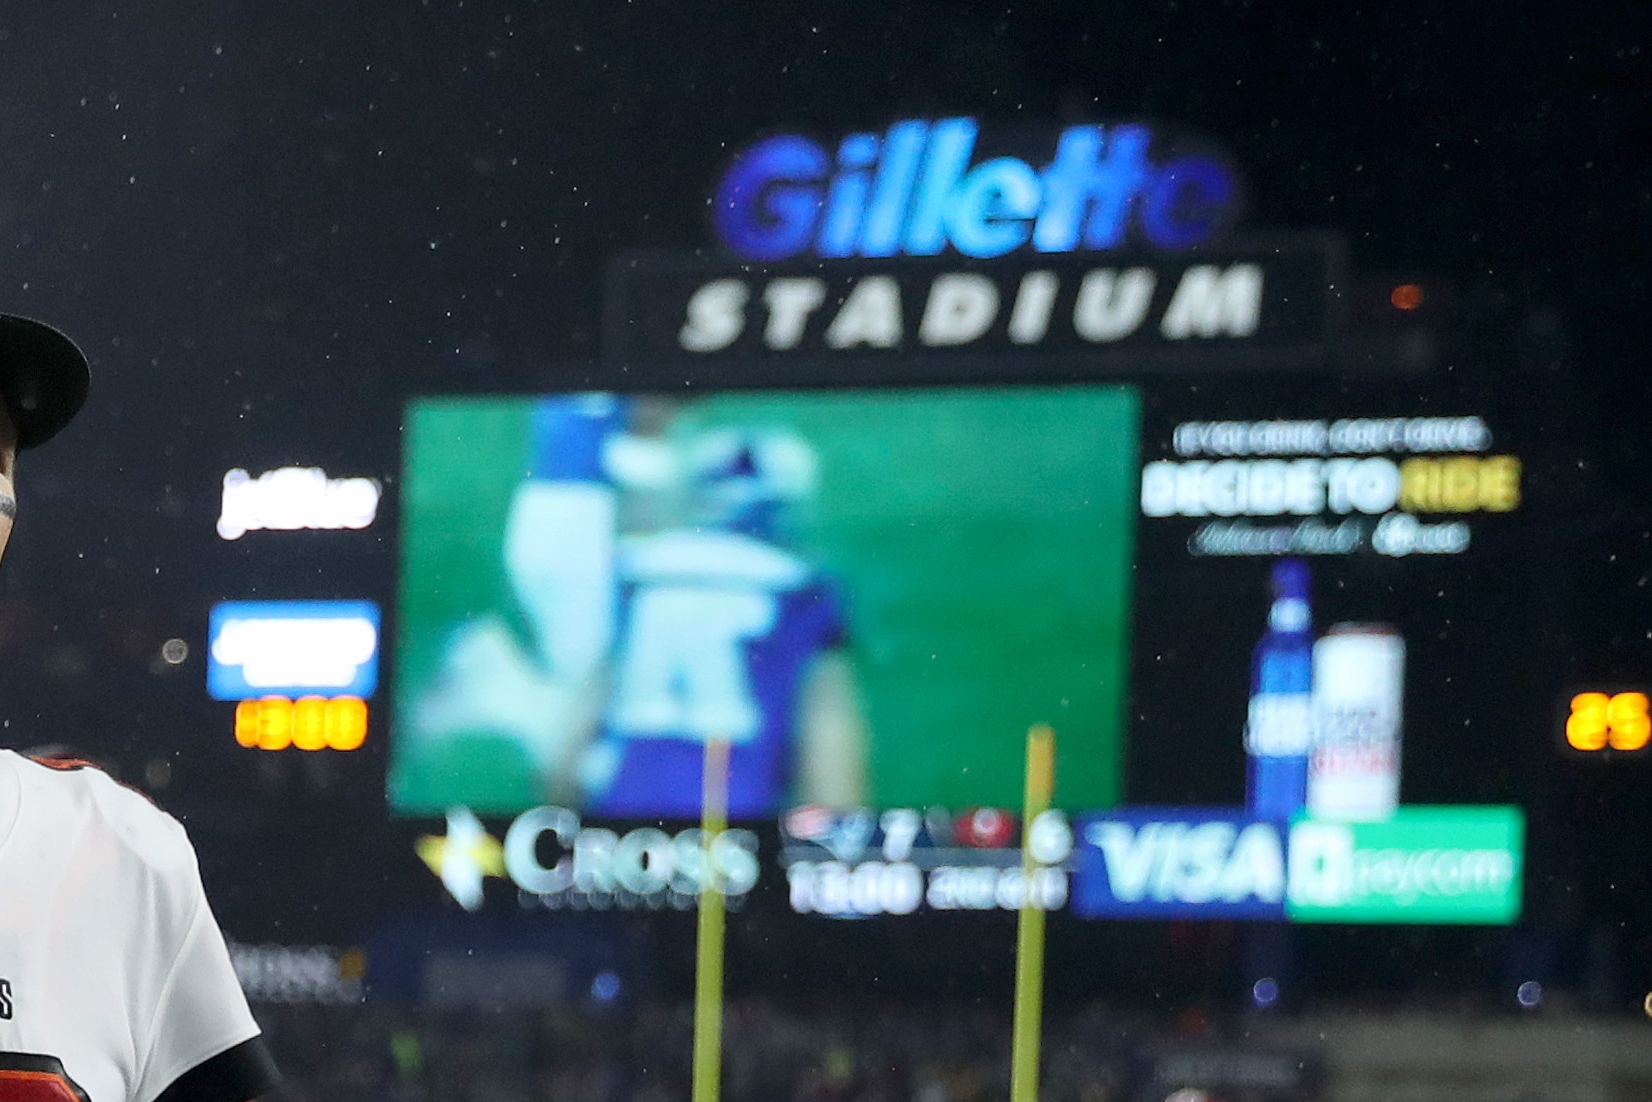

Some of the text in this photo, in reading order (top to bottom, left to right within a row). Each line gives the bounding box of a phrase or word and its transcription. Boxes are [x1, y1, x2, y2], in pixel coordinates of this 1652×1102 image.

[714, 116, 1236, 261] Gillette
[679, 263, 1264, 352] STADIUM
[1141, 454, 1522, 517] DECIDE TO RIDE
[1085, 820, 1288, 904] VISA
